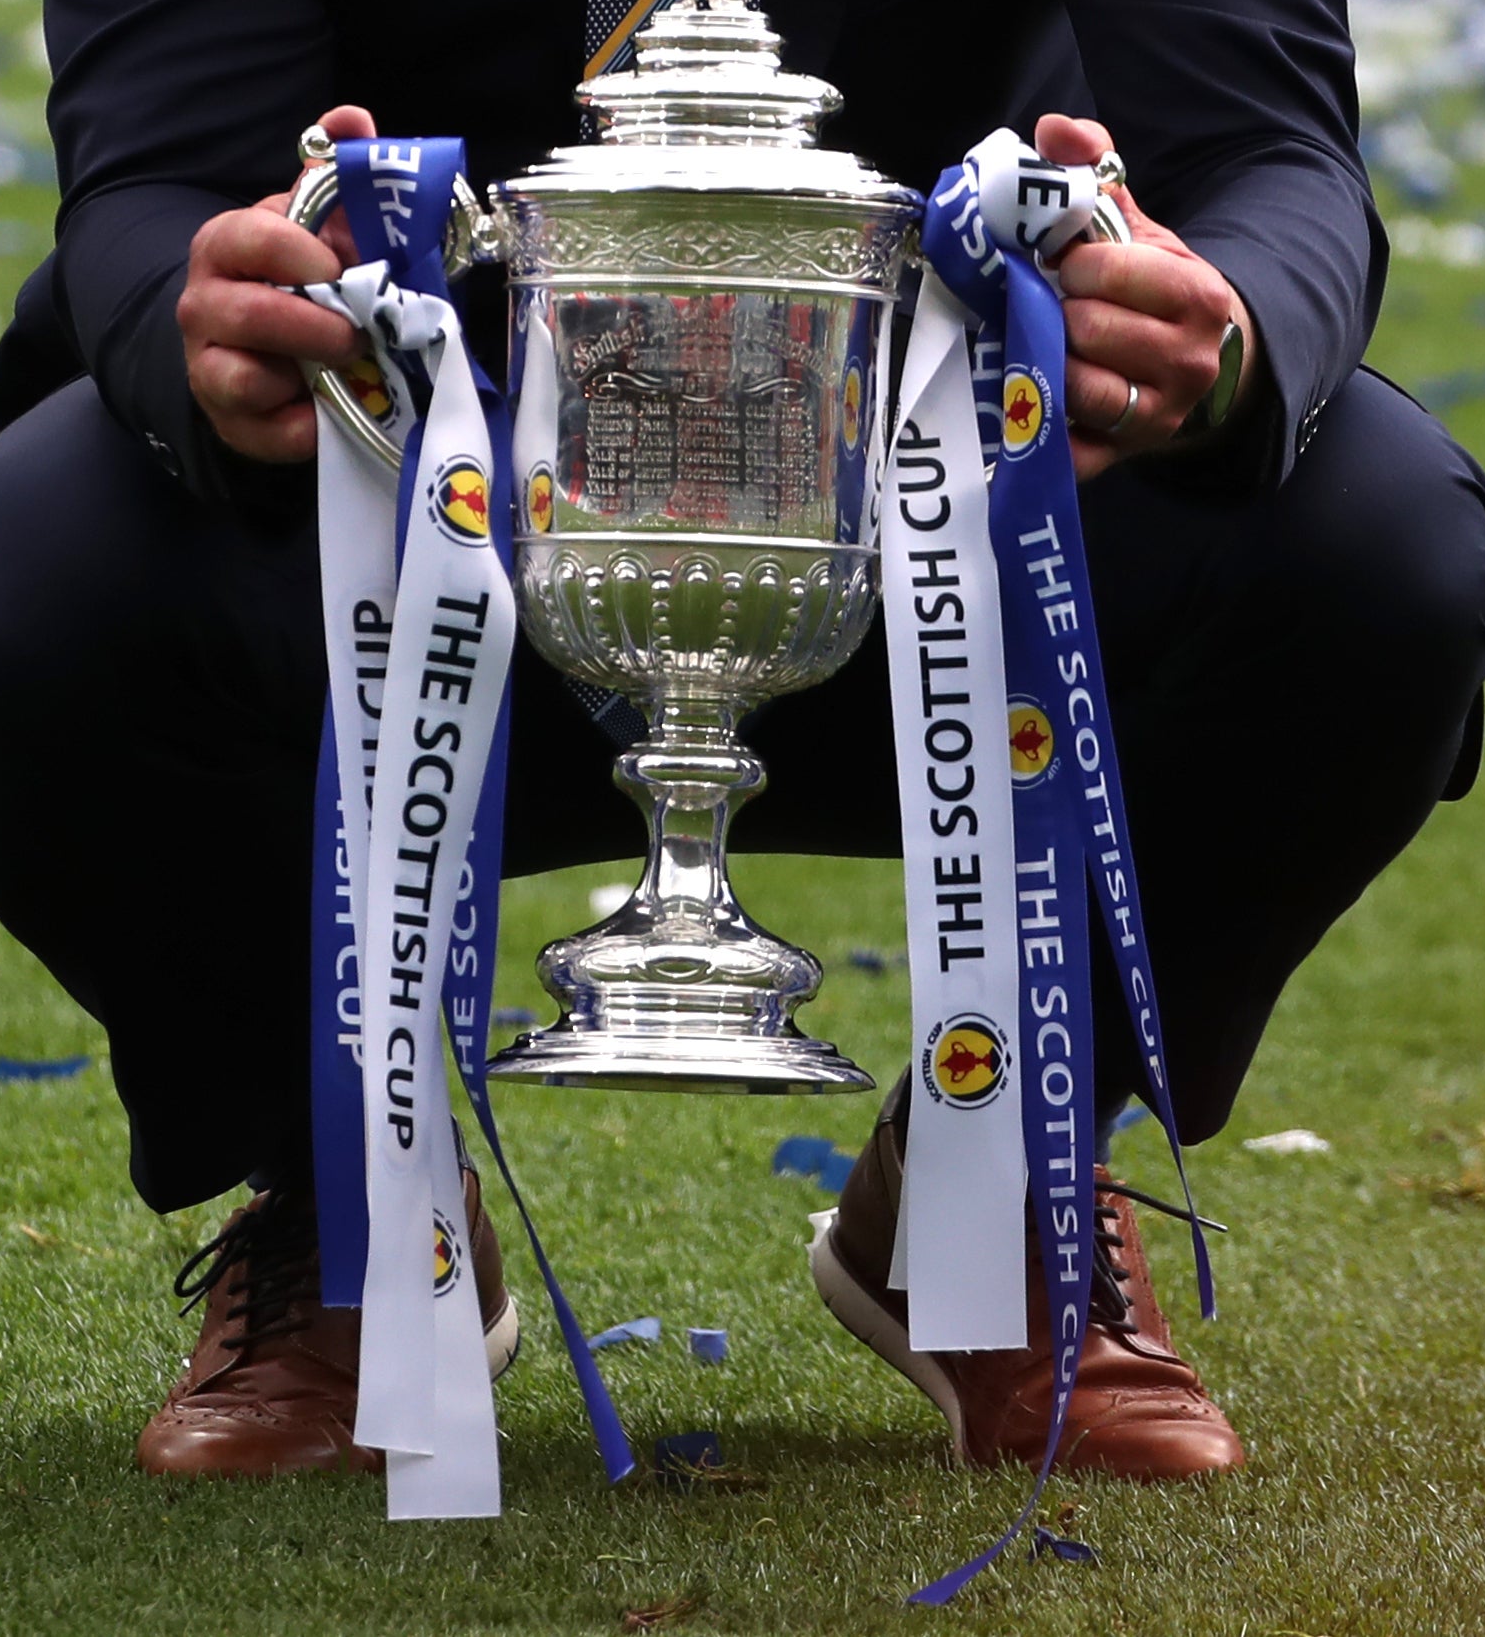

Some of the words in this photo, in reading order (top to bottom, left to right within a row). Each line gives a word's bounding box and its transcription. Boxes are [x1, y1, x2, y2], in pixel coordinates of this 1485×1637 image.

[1030, 366, 1053, 418] SCOTTISH
[1038, 422, 1052, 446] CUP
[897, 418, 952, 532] CUP
[419, 592, 489, 705] THE
[908, 548, 979, 838] SCOTTISH
[1018, 514, 1079, 637] THE
[1058, 650, 1136, 948] SCOTTISH
[1131, 966, 1164, 1090] CUP
[389, 716, 461, 1010] SCOTTISH
[933, 853, 985, 973] THE
[1016, 847, 1065, 969] THE
[386, 1026, 416, 1151] CUP
[921, 1047, 944, 1104] SCOTTISH
[927, 1021, 943, 1045] CUP
[1030, 985, 1080, 1283] SCOTTISH
